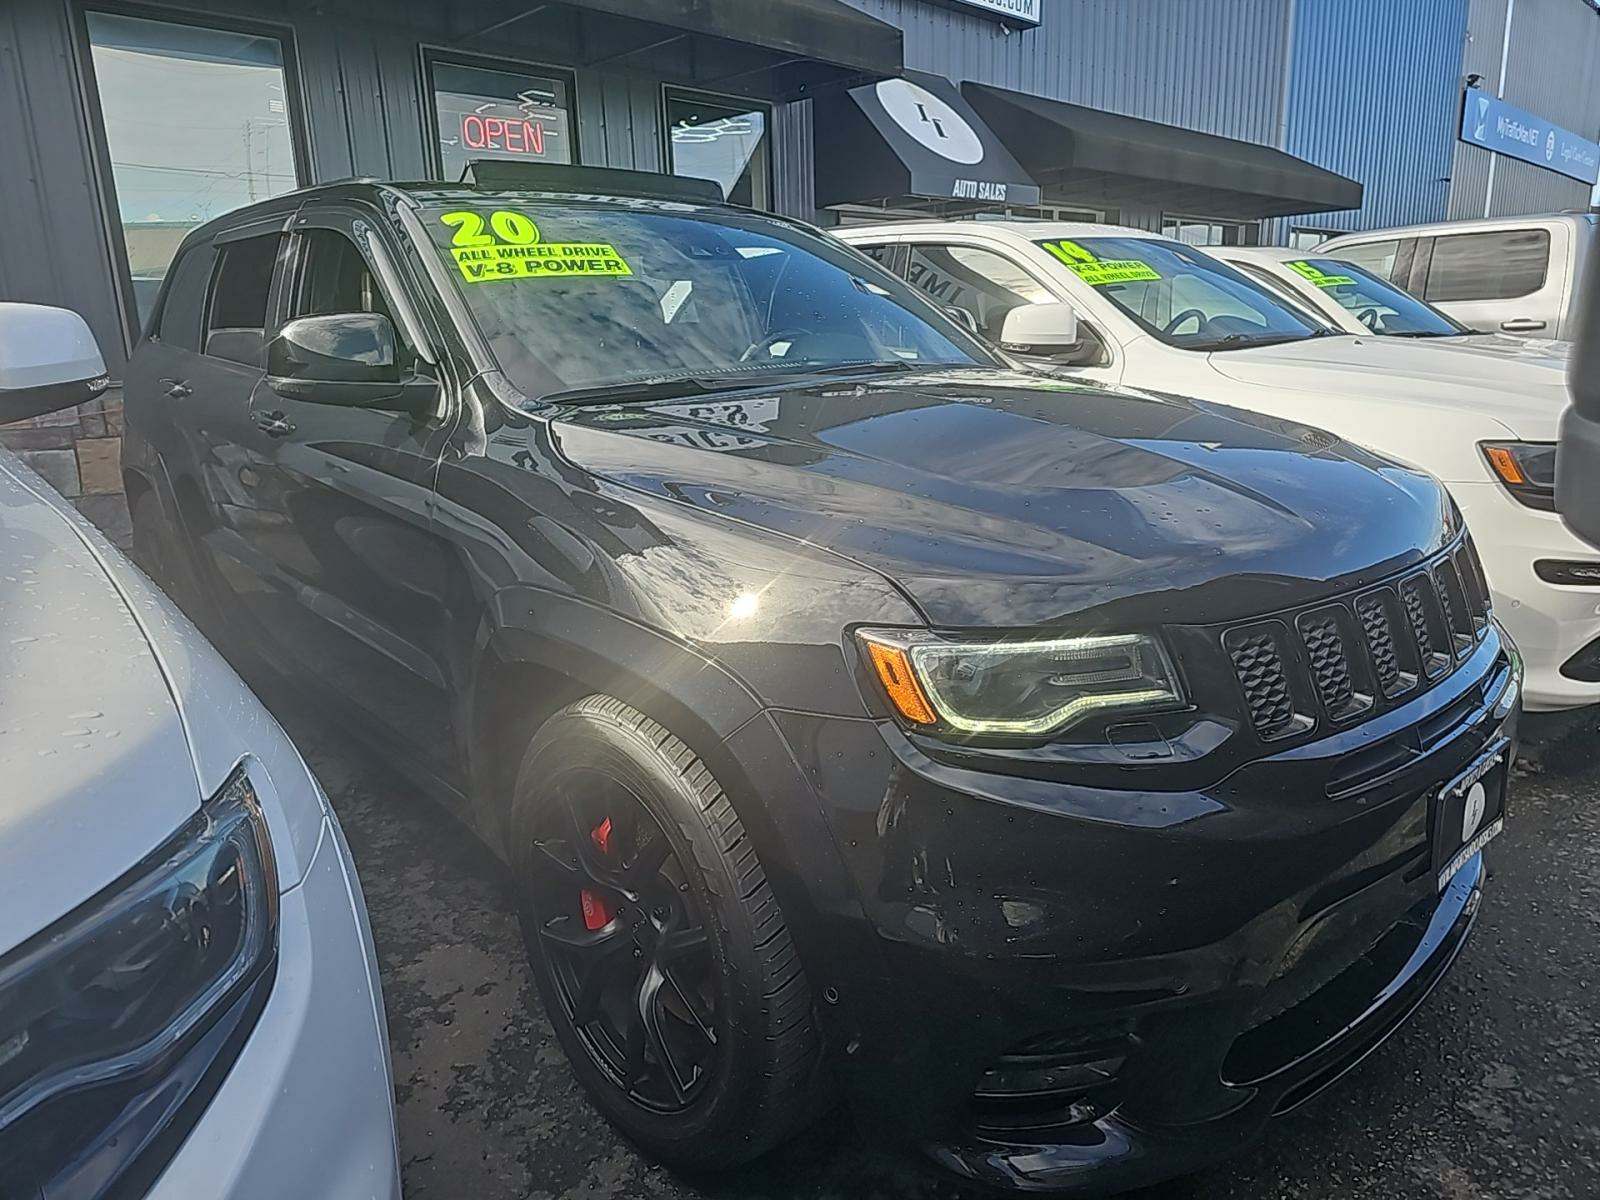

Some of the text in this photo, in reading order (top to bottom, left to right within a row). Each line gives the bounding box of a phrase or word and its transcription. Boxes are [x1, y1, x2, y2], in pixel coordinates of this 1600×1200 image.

[463, 115, 543, 154] OPEN
[952, 179, 1007, 200] AUTO SALES
[440, 211, 540, 246] 20
[458, 247, 611, 262] ALL WHEEL DRIVE
[1042, 241, 1098, 265] 14
[466, 259, 623, 276] V-8 POWER
[1100, 262, 1142, 272] POWER
[1084, 271, 1156, 283] ALL WHEEL DRIVE
